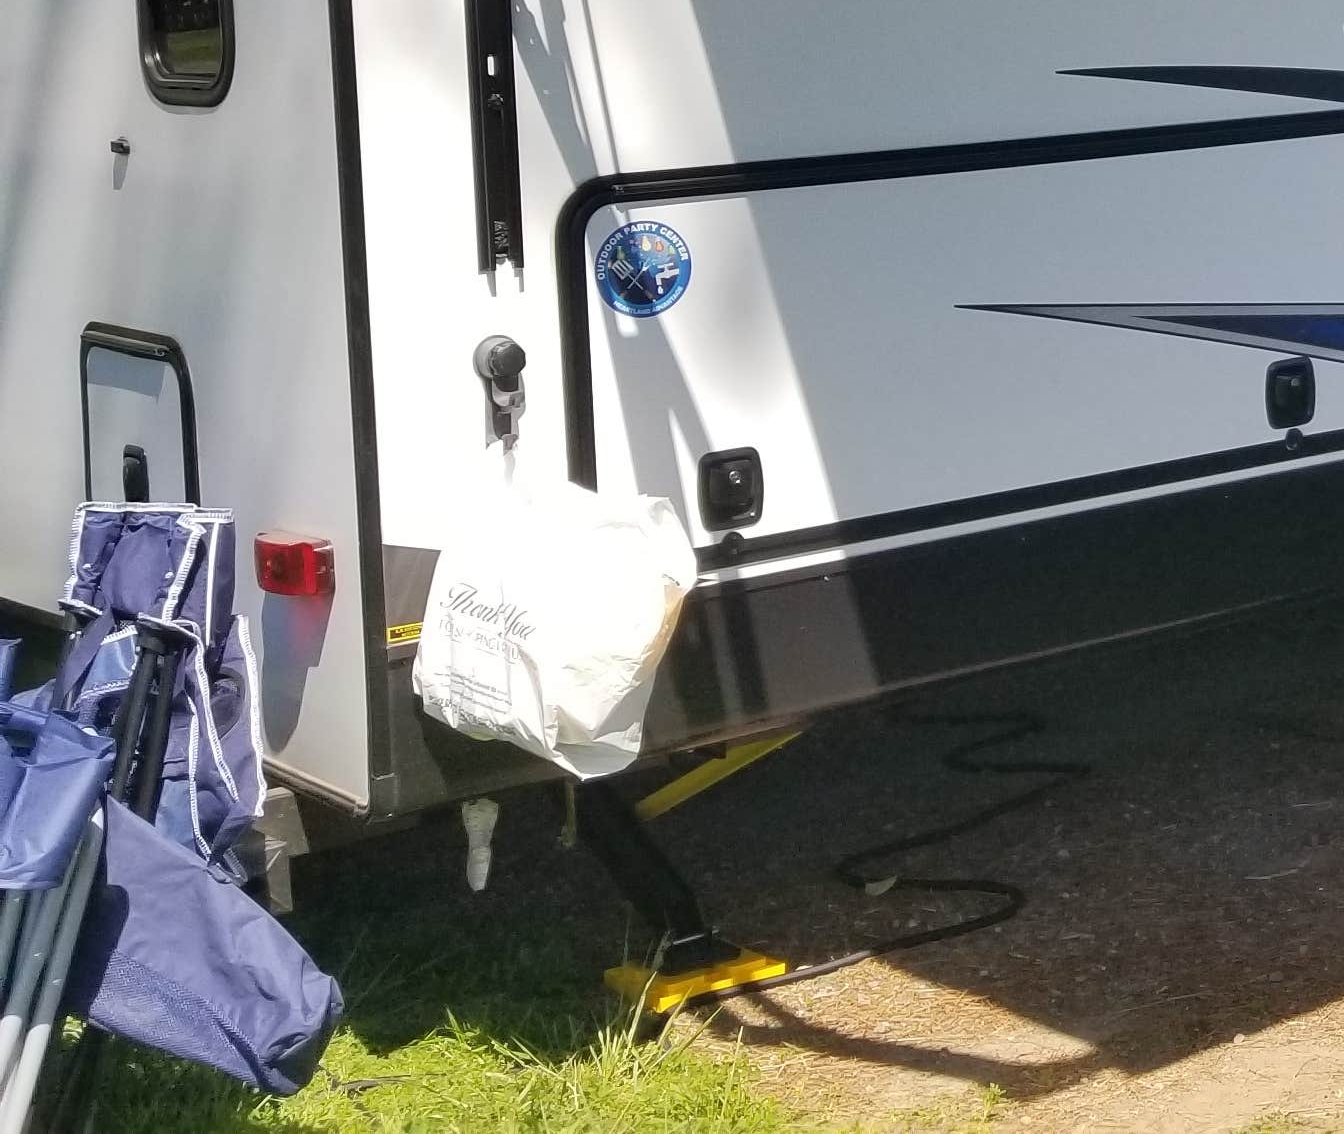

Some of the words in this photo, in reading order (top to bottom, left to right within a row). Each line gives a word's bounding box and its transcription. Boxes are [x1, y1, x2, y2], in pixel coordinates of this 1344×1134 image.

[597, 232, 624, 281] OUTDOOR
[623, 223, 659, 235] PARTY
[660, 226, 689, 261] CENTER
[440, 582, 505, 624] Thank
[497, 603, 537, 640] You
